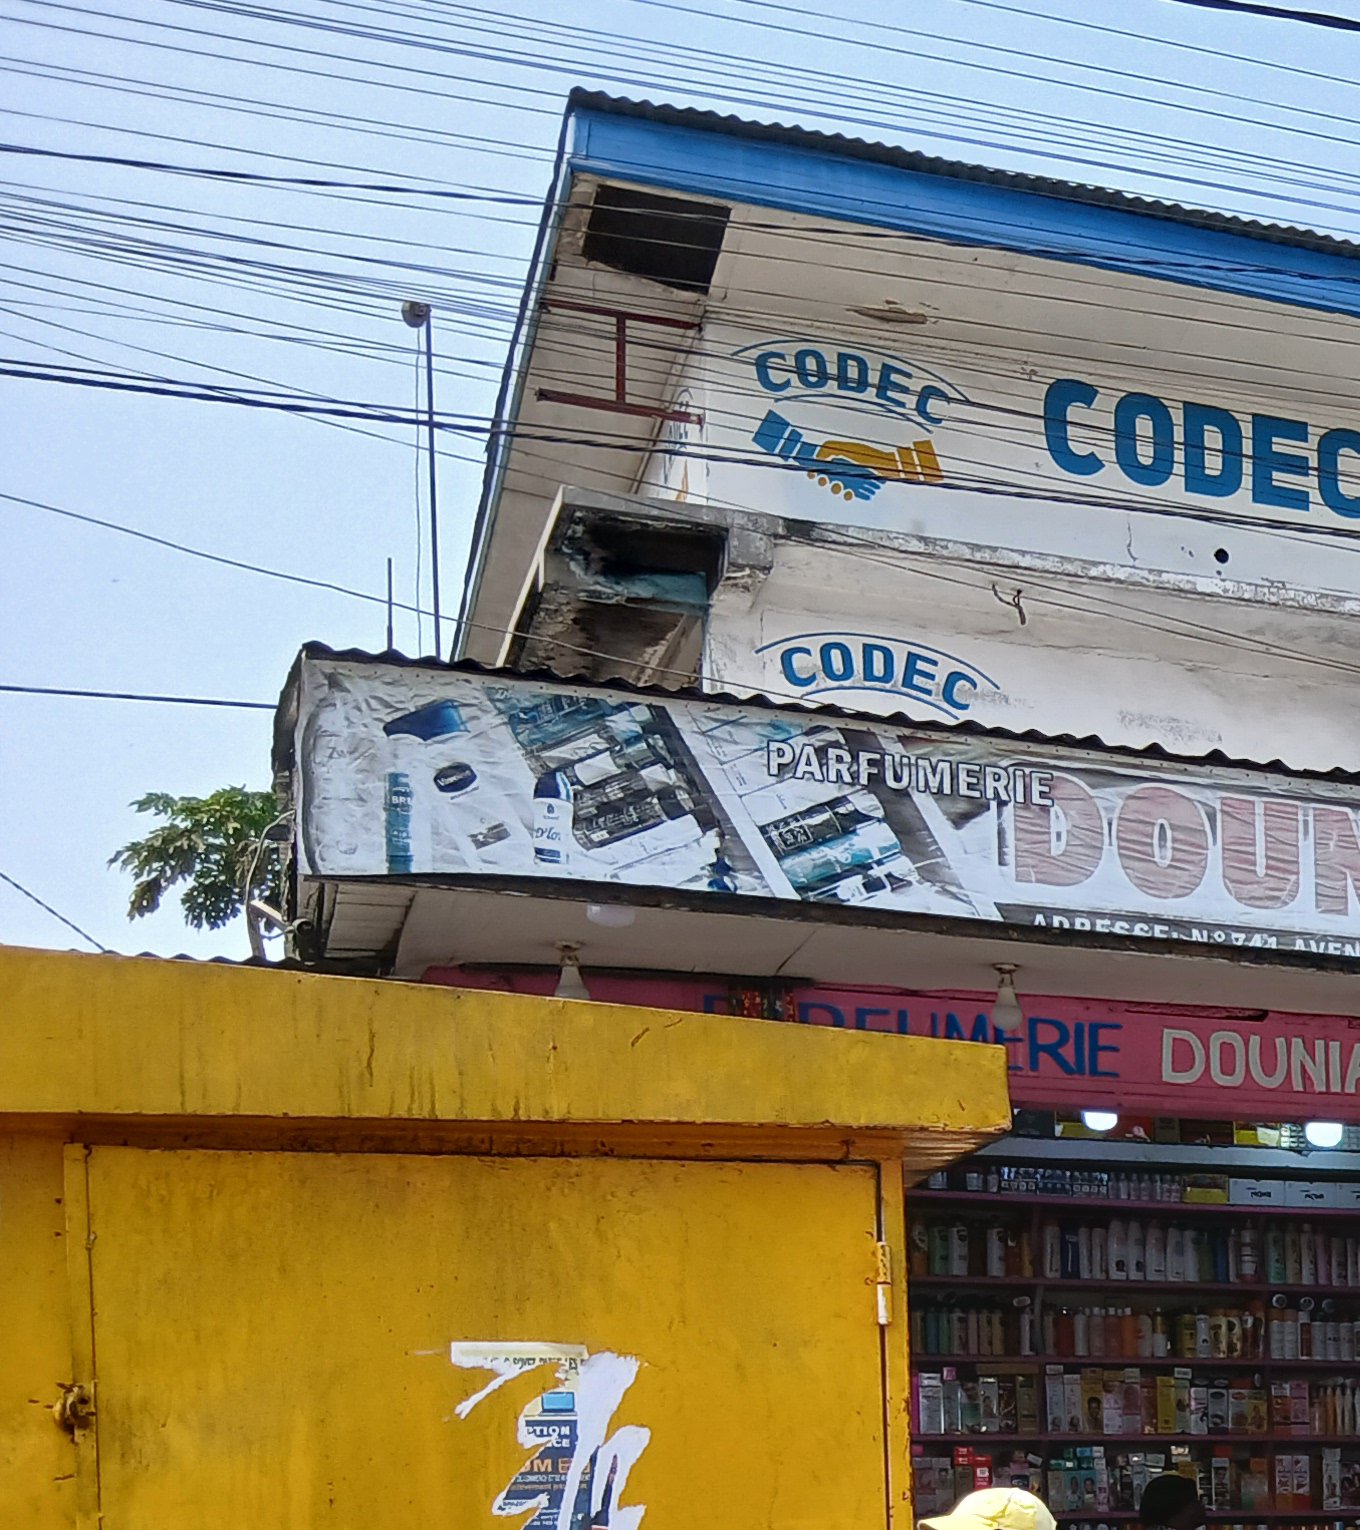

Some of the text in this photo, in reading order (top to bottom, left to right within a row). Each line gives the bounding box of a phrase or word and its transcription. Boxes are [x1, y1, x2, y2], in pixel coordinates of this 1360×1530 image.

[755, 348, 950, 426] CODEC
[781, 640, 977, 713] CODEC
[766, 738, 1056, 808] PARFUMERIE
